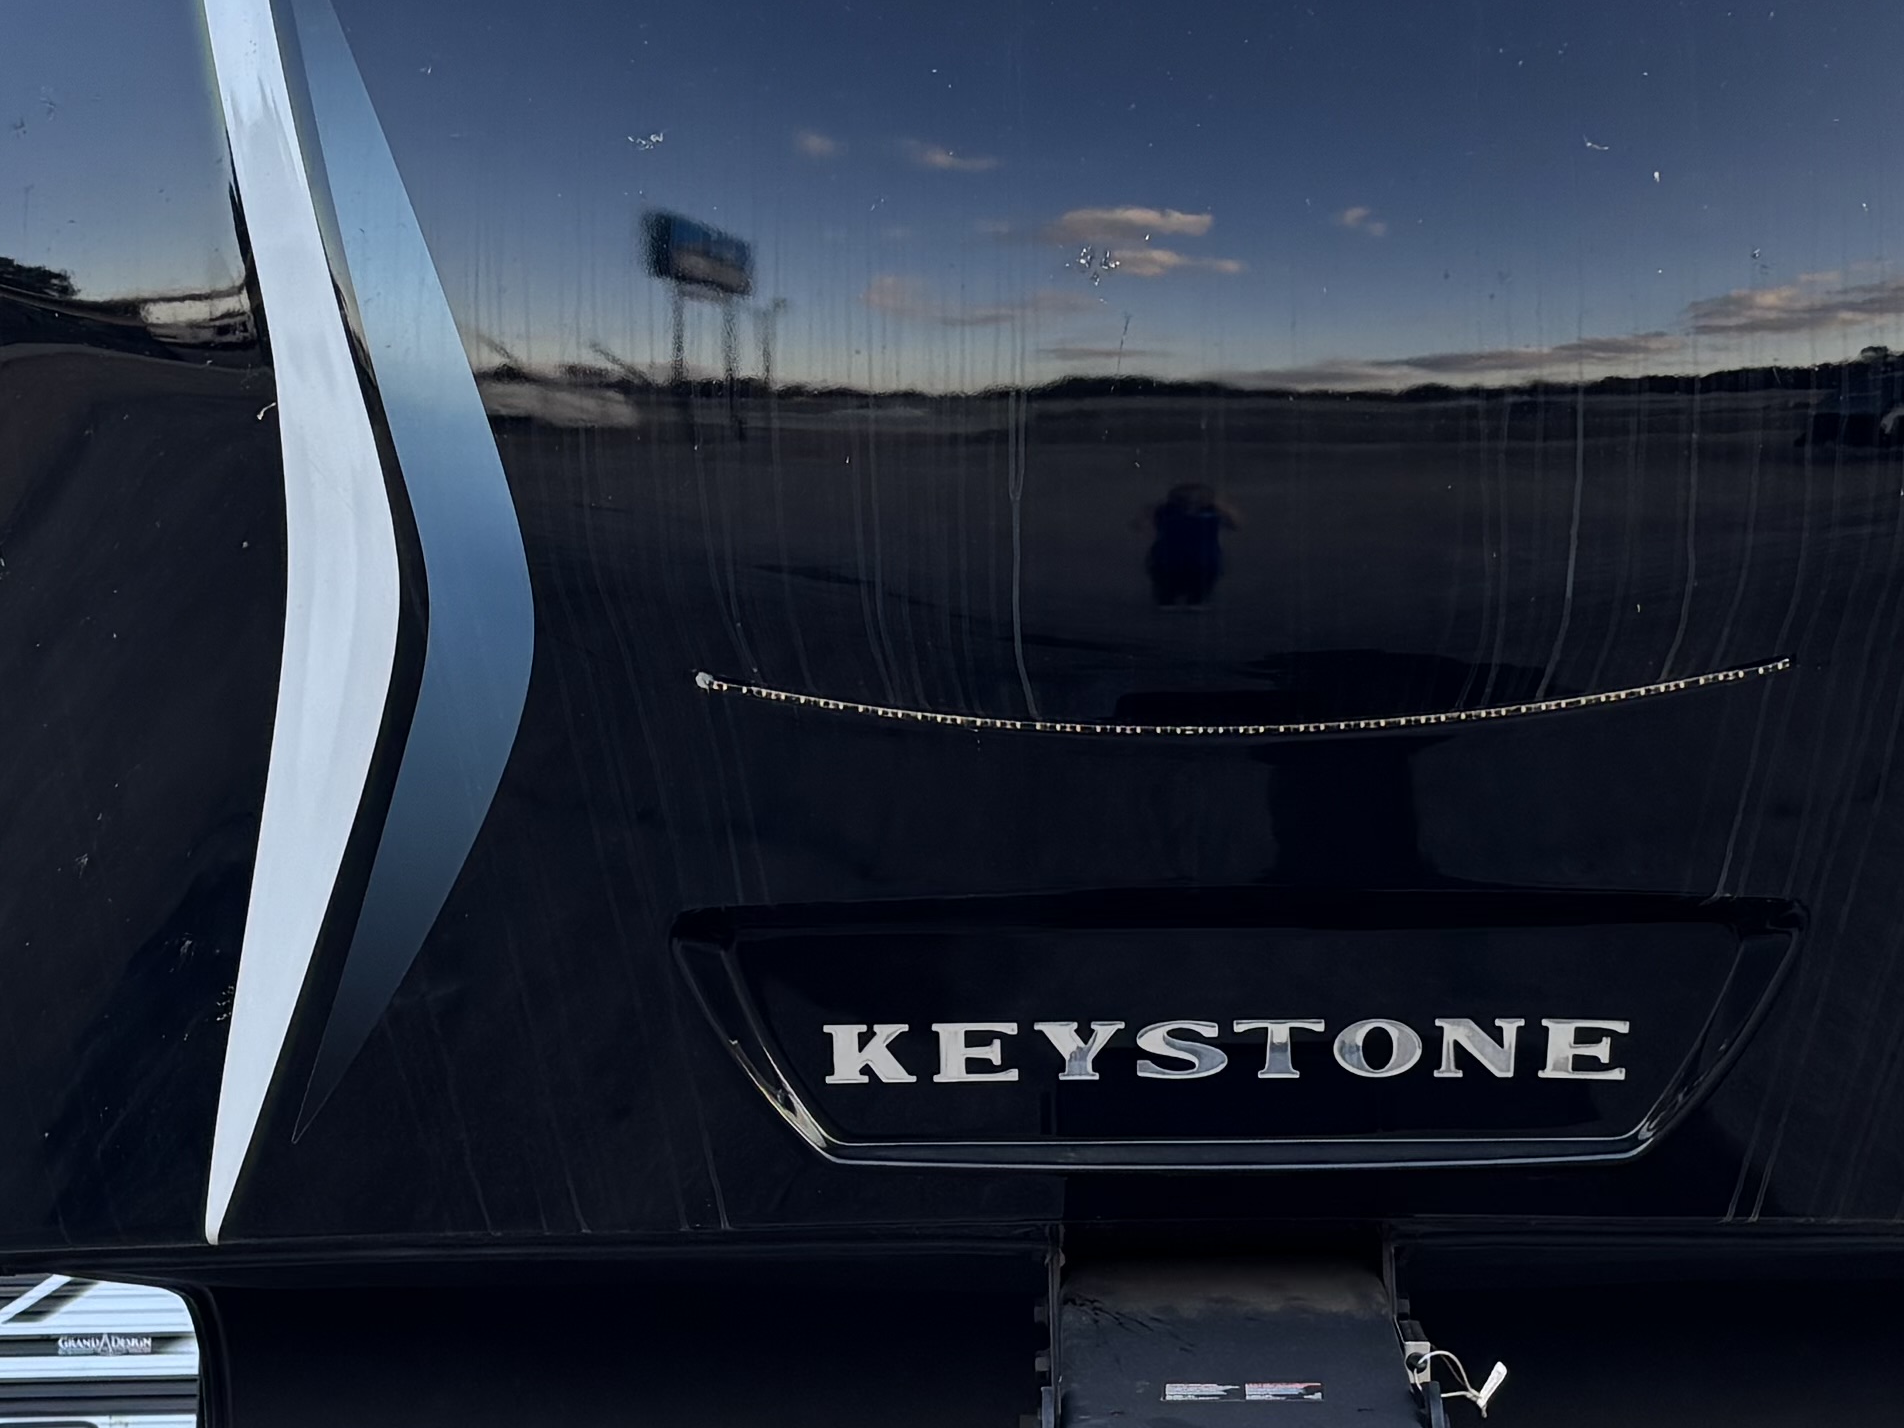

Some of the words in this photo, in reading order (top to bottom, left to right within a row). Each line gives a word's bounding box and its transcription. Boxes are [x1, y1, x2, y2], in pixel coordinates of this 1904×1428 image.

[822, 1016, 1632, 1085] KEYSTONE
[58, 1336, 100, 1349] GRAND
[110, 1335, 152, 1348] DESIGN
